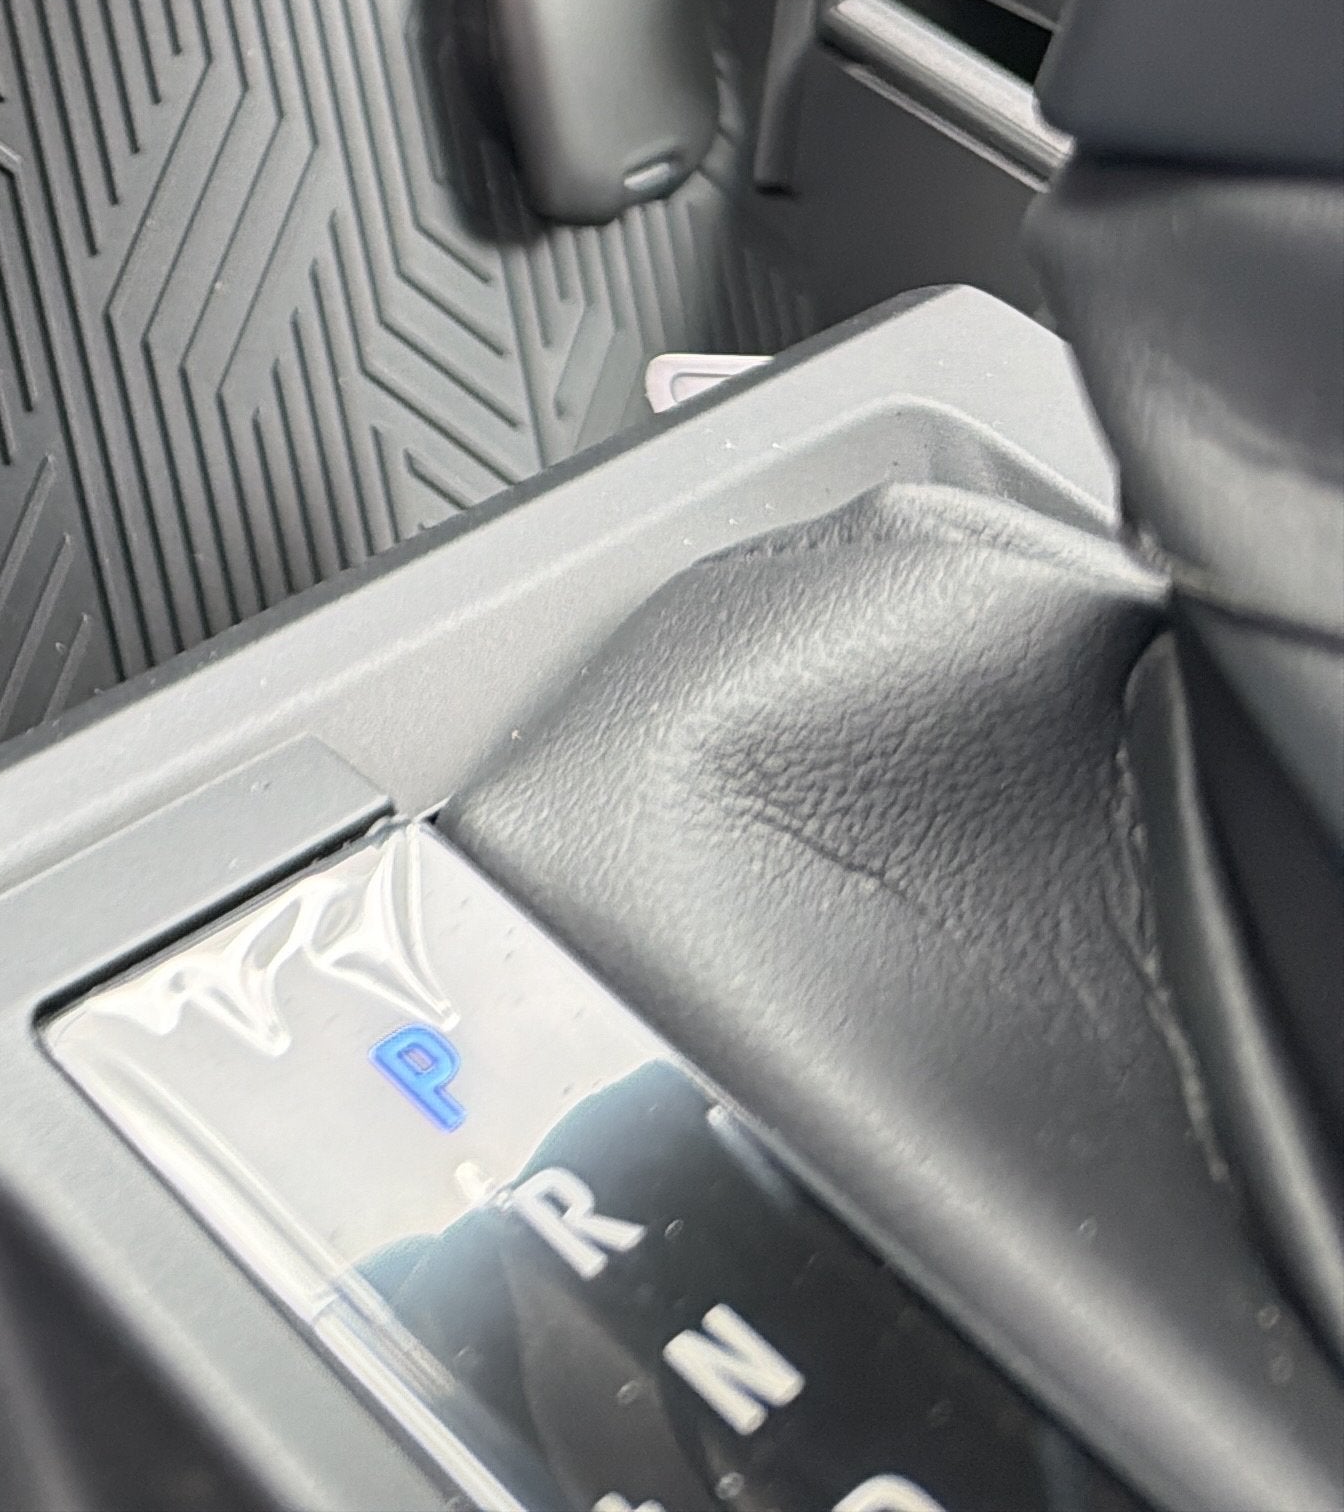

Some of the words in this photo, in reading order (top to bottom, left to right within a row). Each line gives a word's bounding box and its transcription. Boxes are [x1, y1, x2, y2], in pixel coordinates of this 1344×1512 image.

[369, 1024, 466, 1133] P
[510, 1166, 647, 1281] R
[663, 1303, 806, 1436] N
